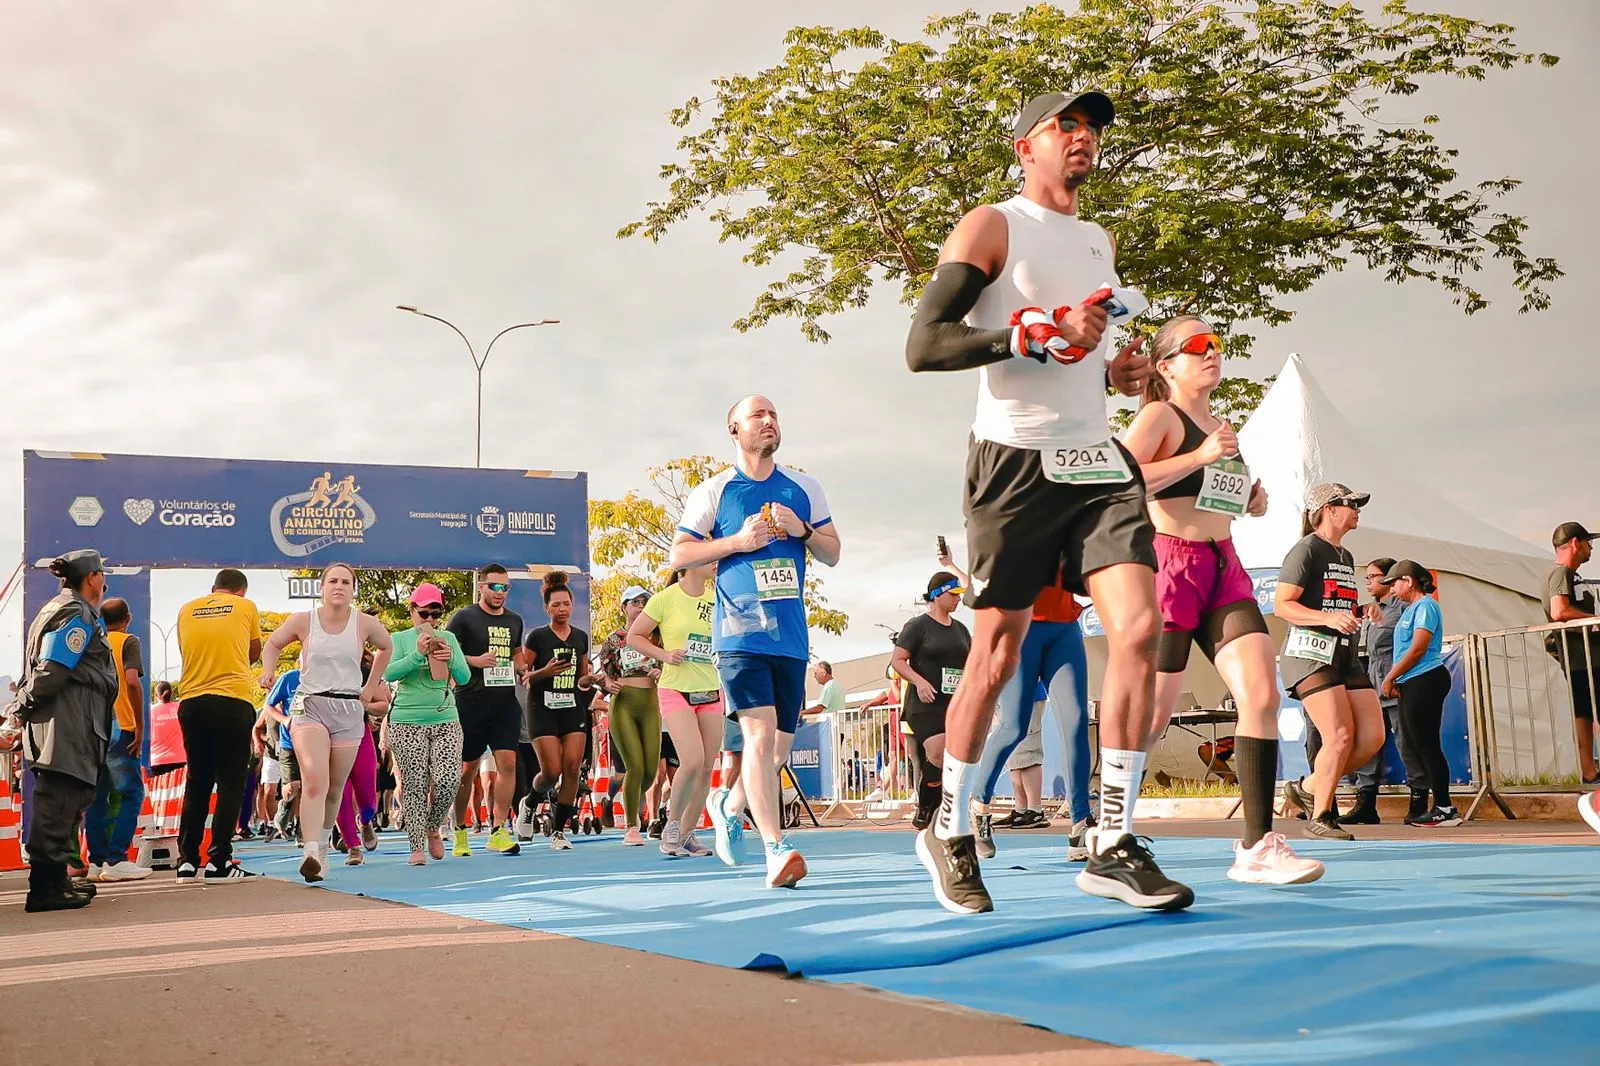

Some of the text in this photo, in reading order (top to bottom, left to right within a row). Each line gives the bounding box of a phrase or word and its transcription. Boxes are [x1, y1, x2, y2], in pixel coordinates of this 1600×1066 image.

[1055, 449, 1108, 466] 5294
[1211, 473, 1243, 495] 5692
[159, 499, 236, 511] Voluntários de
[159, 510, 236, 528] Coração
[292, 507, 356, 518] CIRCUITO
[284, 518, 363, 529] ANAPOLINO
[508, 511, 556, 530] ANÁPOLIS
[761, 570, 793, 584] 1454
[488, 626, 511, 637] PACE
[489, 637, 511, 646] SUNSET
[1297, 635, 1327, 650] 1100
[489, 645, 510, 658] FOOD
[489, 668, 510, 677] 4878
[553, 676, 575, 689] RUN
[1101, 783, 1125, 831] RUN
